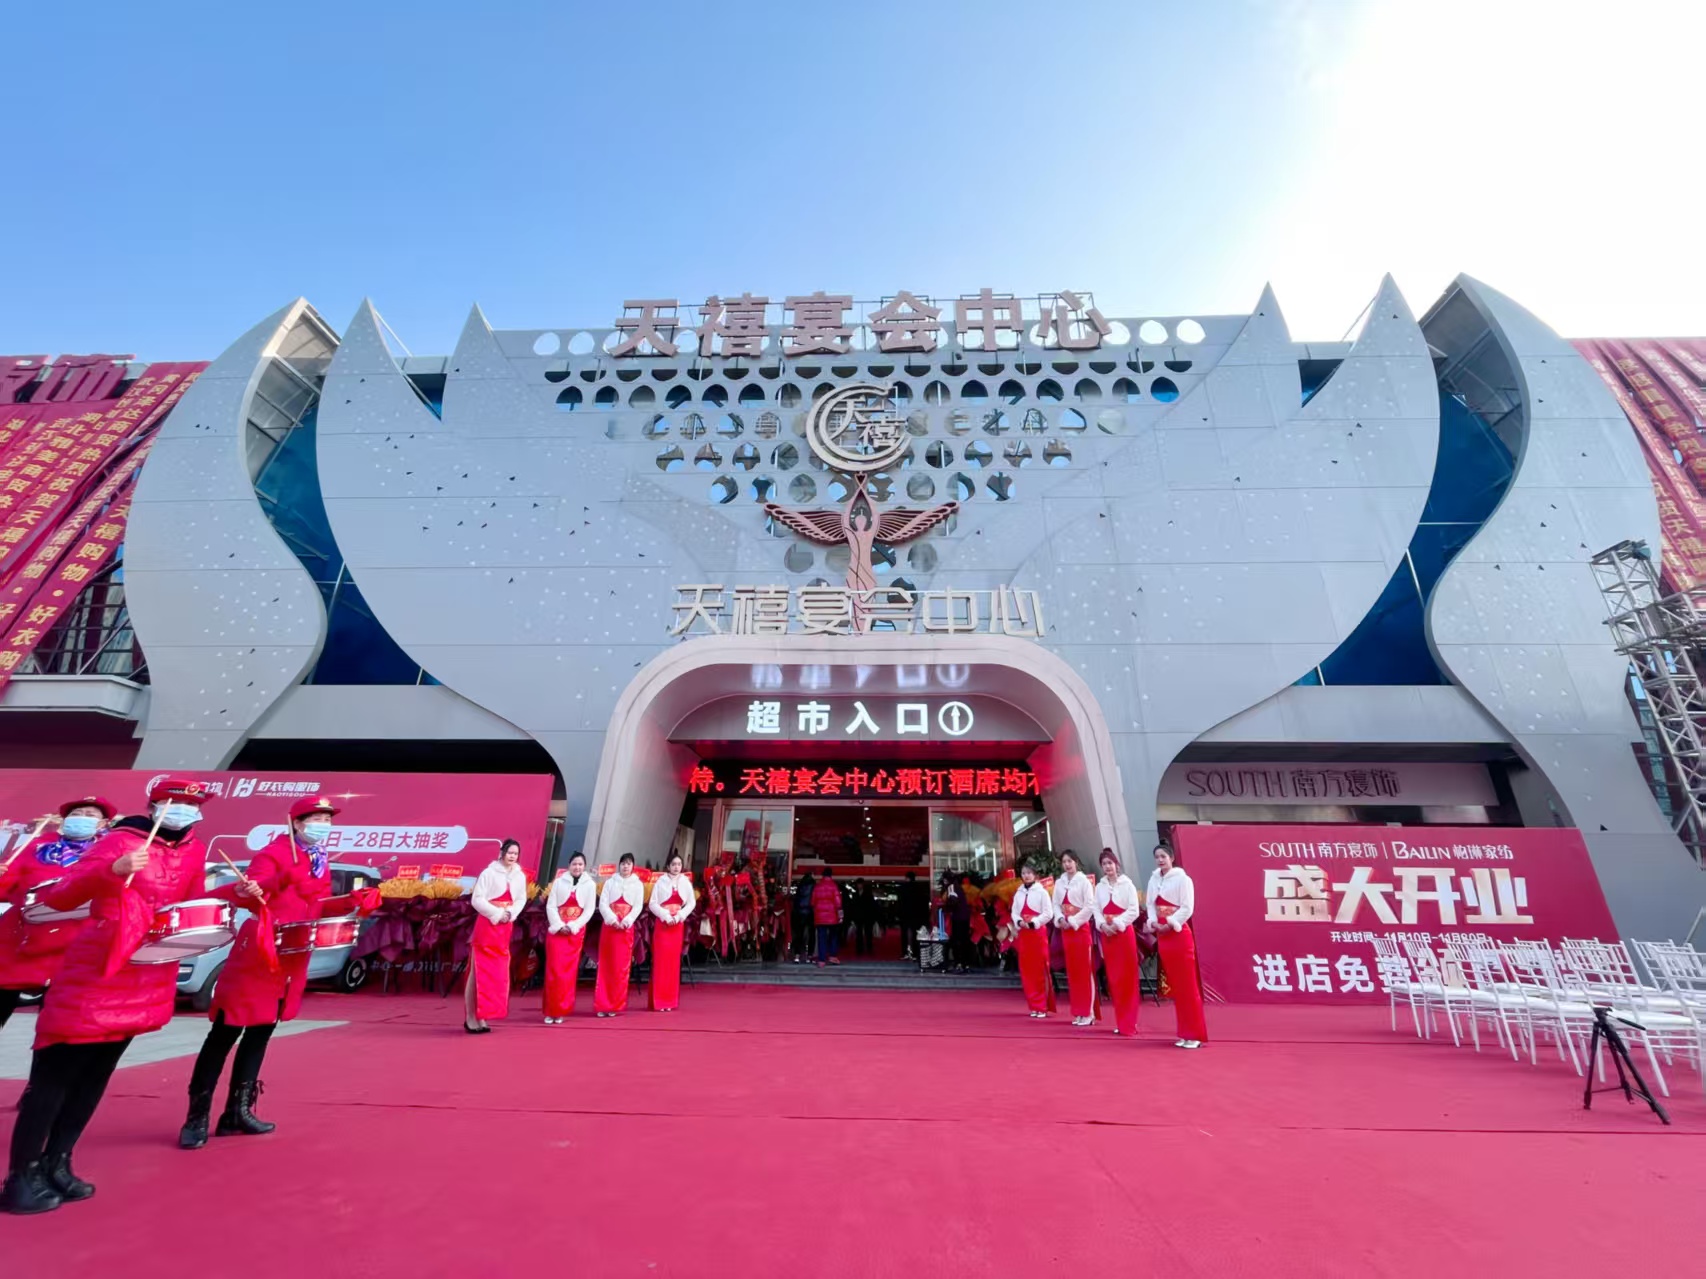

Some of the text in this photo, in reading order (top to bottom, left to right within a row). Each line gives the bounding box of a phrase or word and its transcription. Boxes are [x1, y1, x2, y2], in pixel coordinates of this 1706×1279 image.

[610, 288, 1111, 357] 天禧宴会中心
[671, 584, 1045, 637] 天禧宴会中心
[746, 701, 928, 735] 超市入口
[1187, 769, 1288, 798] SOUTH
[1259, 842, 1316, 858] SOUTH
[1391, 841, 1451, 859] BAILIN
[1263, 864, 1534, 925] 盛大开业
